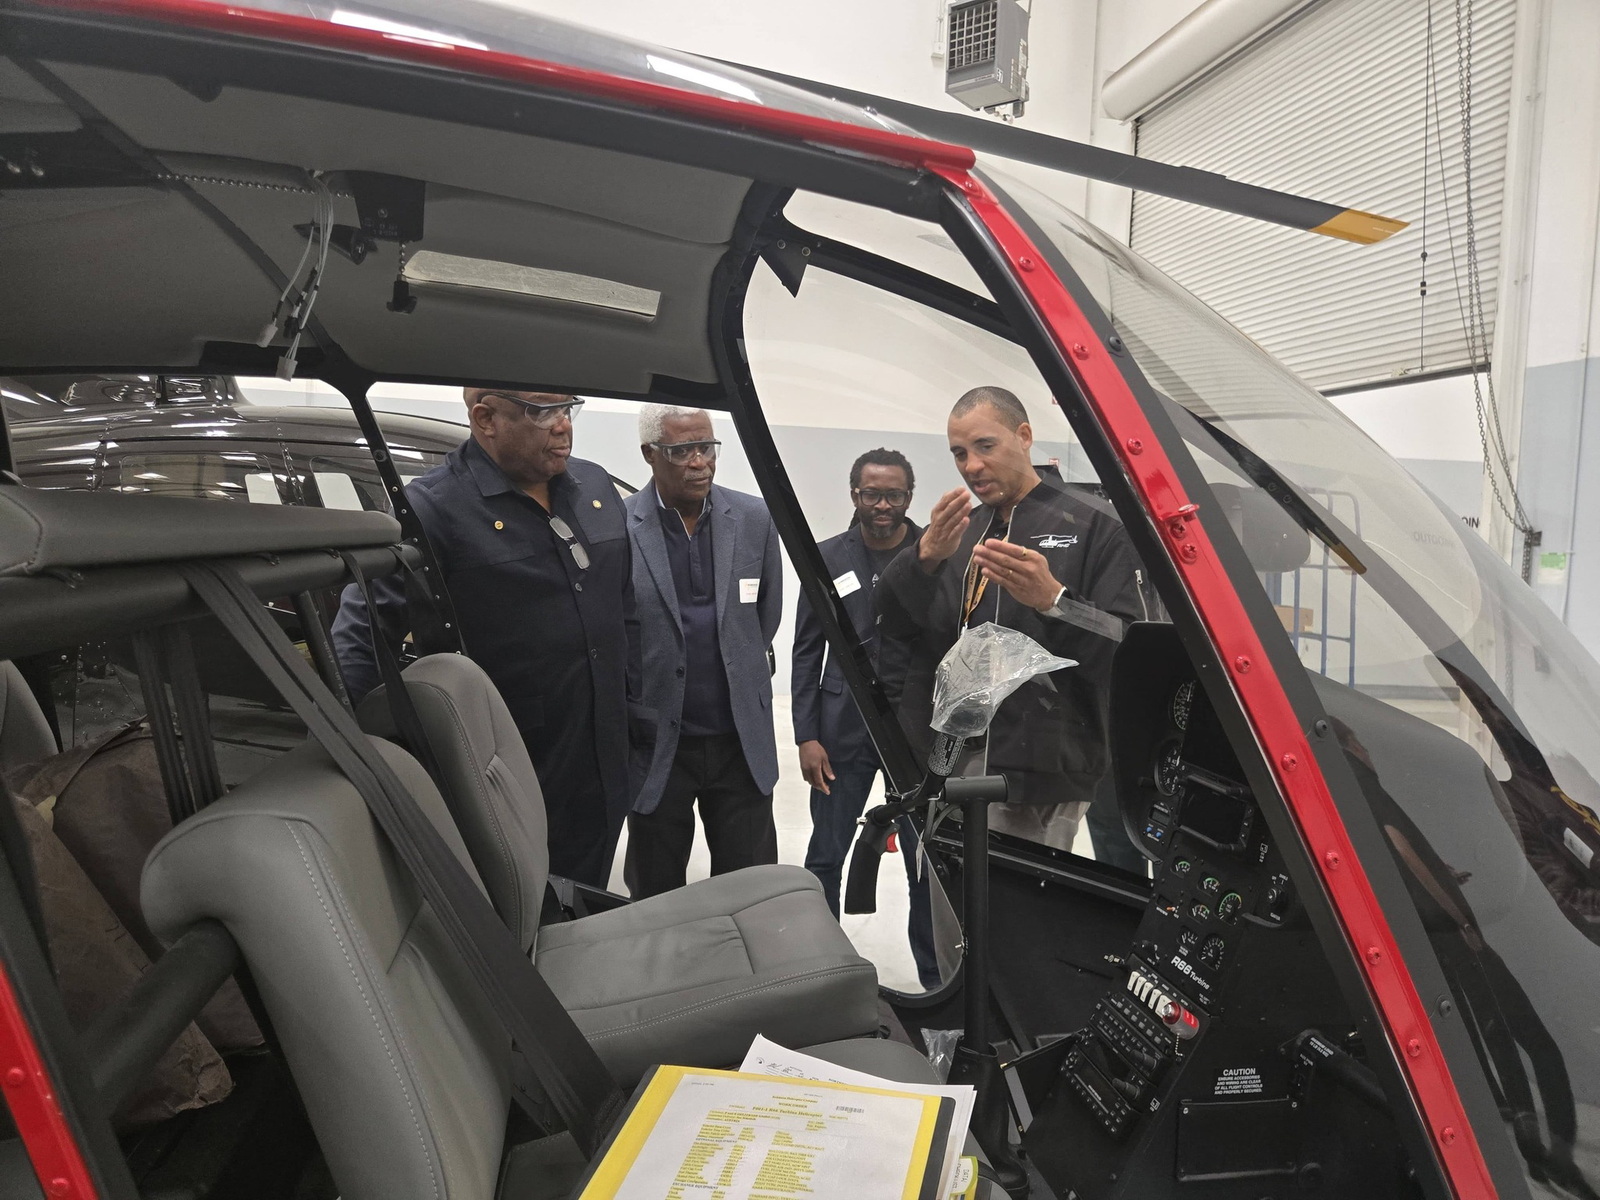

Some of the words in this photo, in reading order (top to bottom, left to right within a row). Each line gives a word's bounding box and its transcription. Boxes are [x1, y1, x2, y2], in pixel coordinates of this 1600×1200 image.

[1171, 955, 1193, 975] R66
[1190, 971, 1210, 990] Turbine
[1222, 1067, 1256, 1076] CAUTION
